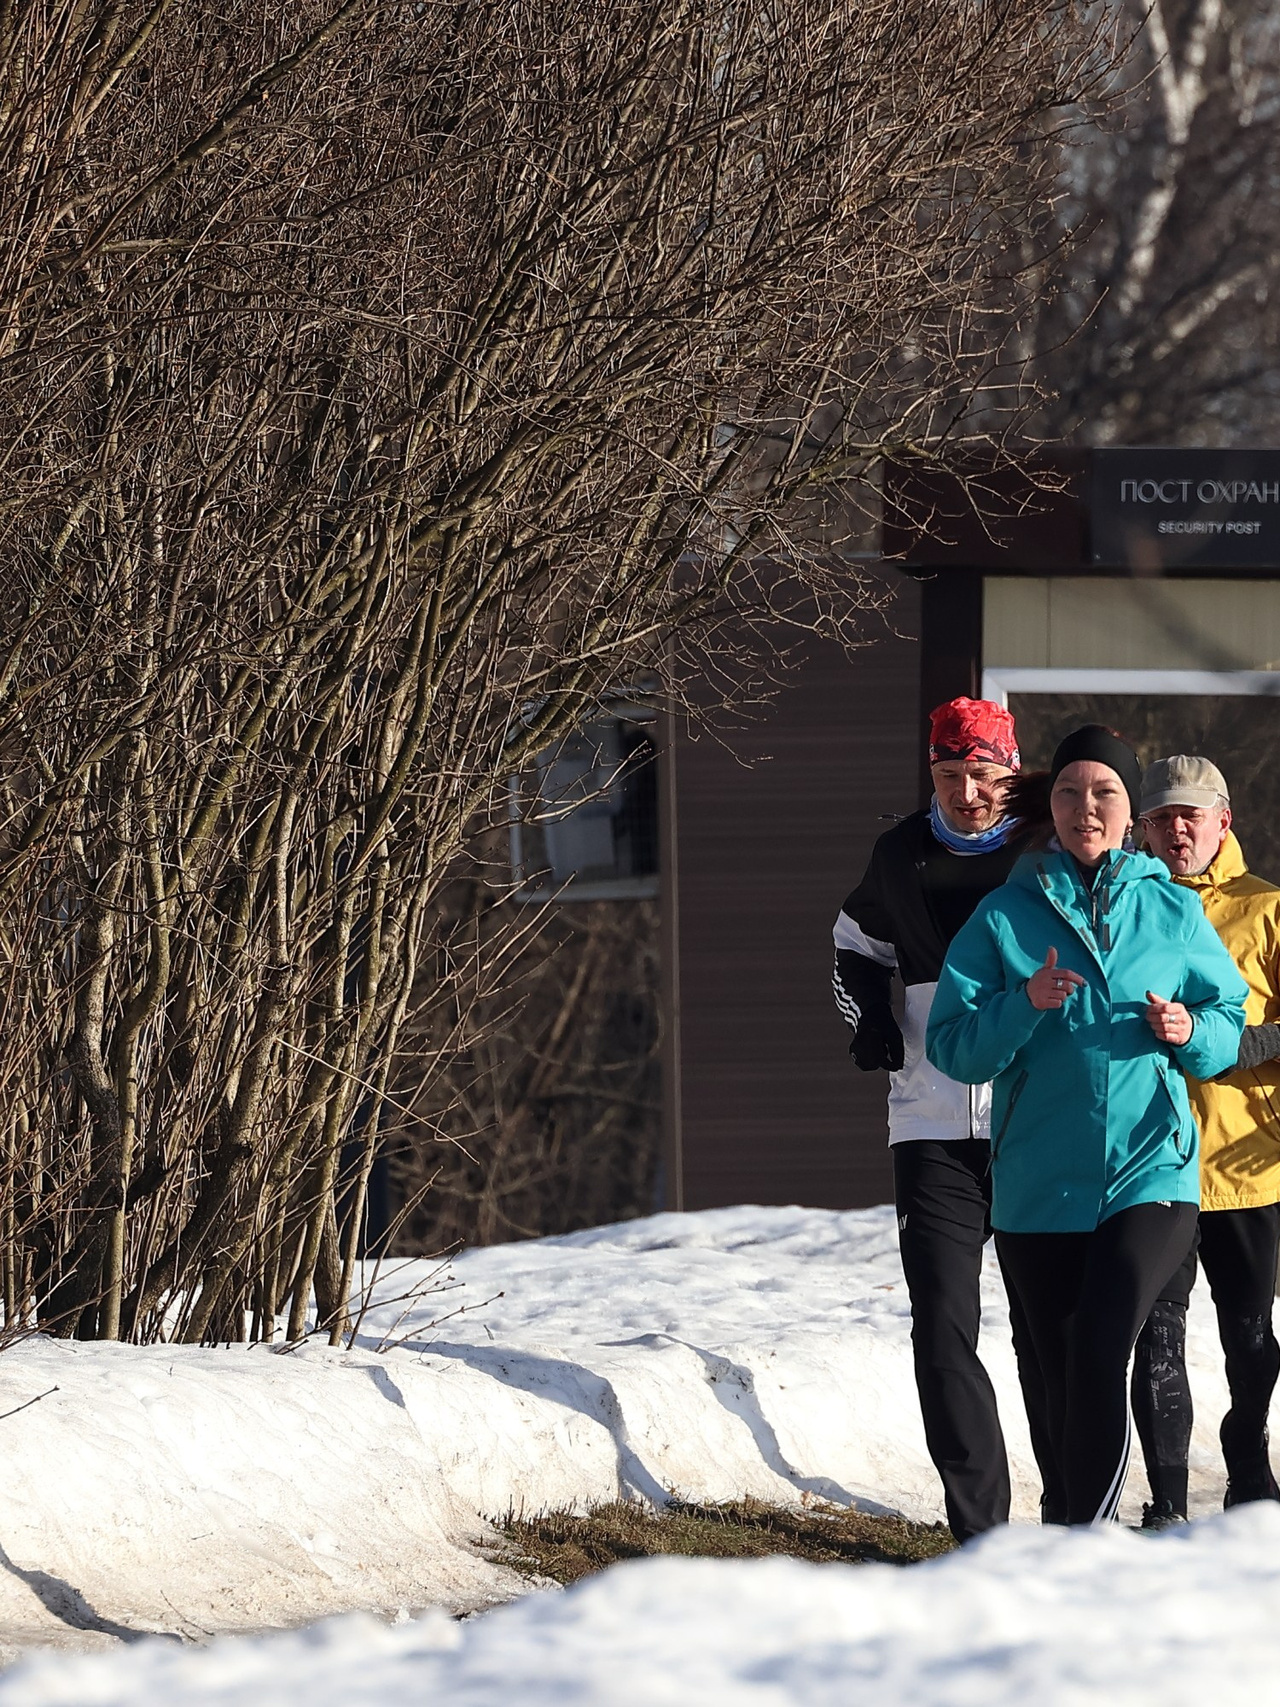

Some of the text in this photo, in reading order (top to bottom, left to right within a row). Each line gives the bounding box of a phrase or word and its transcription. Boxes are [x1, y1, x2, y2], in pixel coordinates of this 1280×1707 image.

[1120, 479, 1193, 504] ПОСТ
[1158, 521, 1262, 534] SECURITY POST
